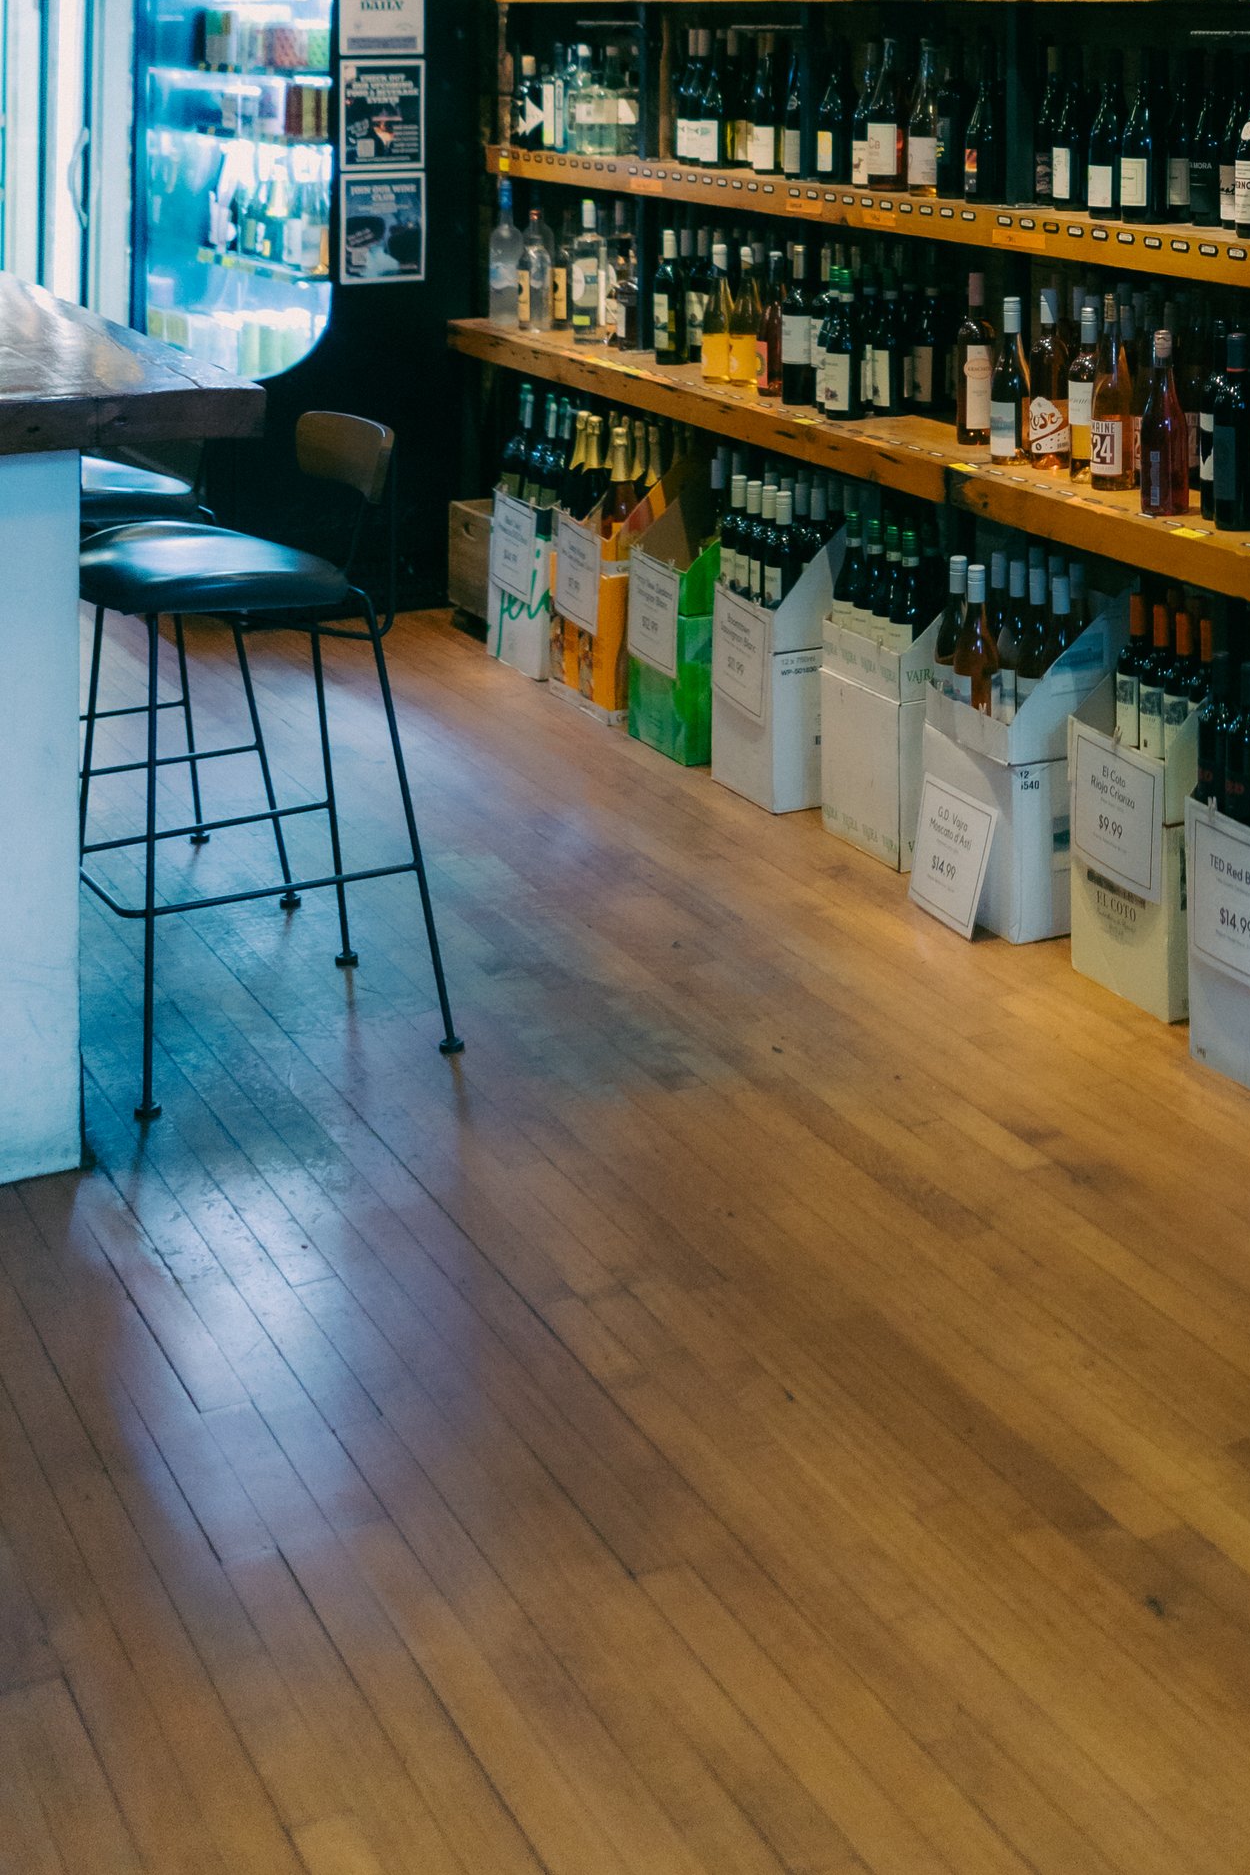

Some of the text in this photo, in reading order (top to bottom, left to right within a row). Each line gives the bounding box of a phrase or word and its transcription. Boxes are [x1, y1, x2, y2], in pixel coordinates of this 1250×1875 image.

[360, 0, 404, 11] DAILY
[1089, 774, 1136, 811] Rioja Crianza
[1110, 771, 1127, 789] Coto
[929, 816, 954, 842] Moscato
[1097, 813, 1124, 840] $9.99
[931, 855, 957, 882] $14.99
[1209, 853, 1225, 874] TED
[1226, 863, 1244, 883] Red
[1096, 890, 1109, 909] EL
[1110, 898, 1137, 924] COTO
